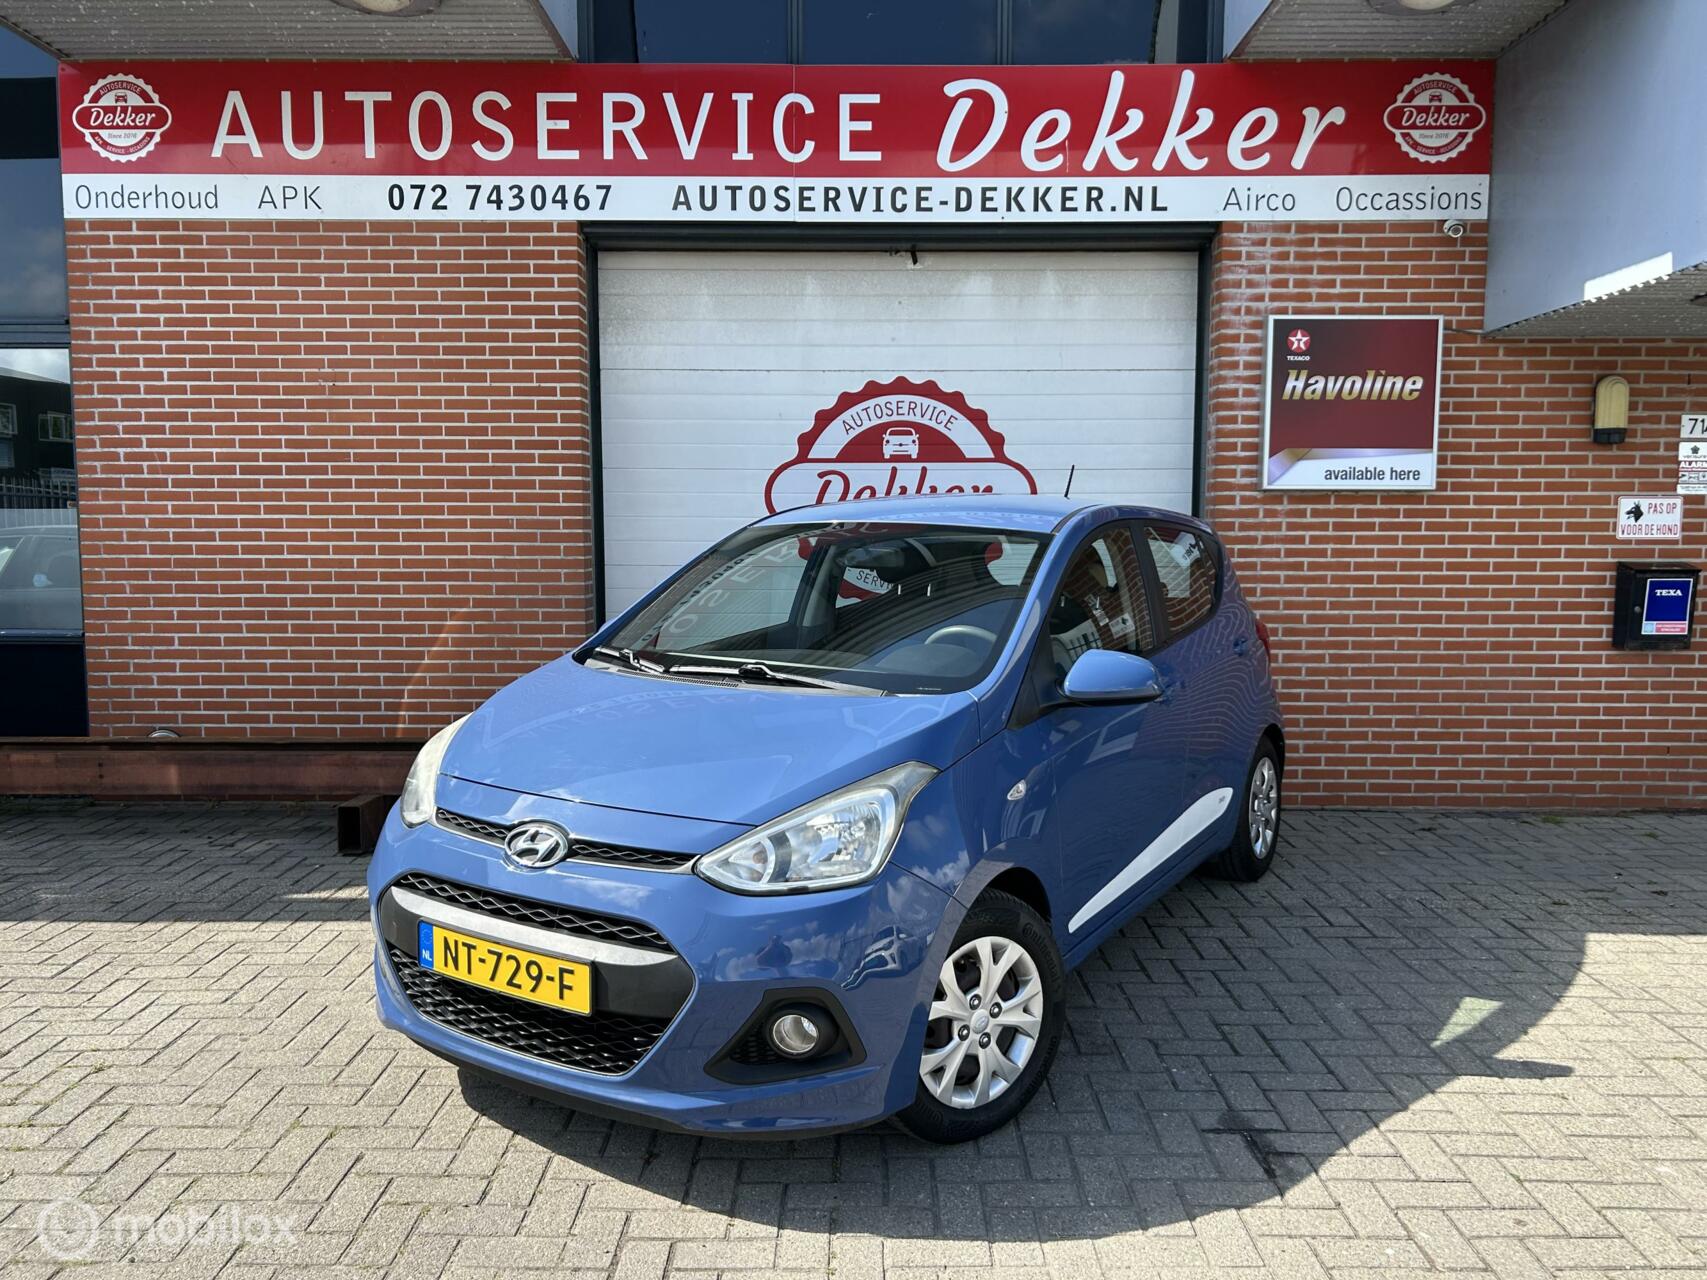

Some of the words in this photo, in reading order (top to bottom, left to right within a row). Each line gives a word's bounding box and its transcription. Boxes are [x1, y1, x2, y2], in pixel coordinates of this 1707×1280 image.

[99, 81, 141, 96] AUTOSERVICE
[1413, 80, 1457, 95] AUTOSERVICE
[90, 106, 156, 126] Dekker
[211, 89, 882, 163] AUTOSERVICE
[936, 69, 1347, 172] Dekker
[1401, 105, 1471, 126] Dekker
[75, 184, 219, 210] Onderhoud
[258, 185, 323, 210] APK
[388, 184, 448, 211] 072
[465, 184, 613, 212] 7430467
[672, 184, 1168, 213] AUTOSERVICE-DEKKER.NL
[1222, 187, 1296, 212] Airco
[1336, 186, 1482, 212] Occassions
[1281, 369, 1424, 401] Havoline
[841, 400, 958, 435] AUTOSERVICE
[1324, 466, 1385, 481] available
[1389, 466, 1421, 481] here
[815, 465, 993, 505] Dkk
[1647, 502, 1664, 514] PAS
[1666, 502, 1678, 514] OP
[1620, 523, 1642, 536] VOOR
[1644, 523, 1655, 536] DE
[1656, 523, 1679, 536] HOND
[1655, 589, 1683, 597] TEXA
[422, 949, 432, 962] NL
[443, 935, 575, 1001] NT-729-F
